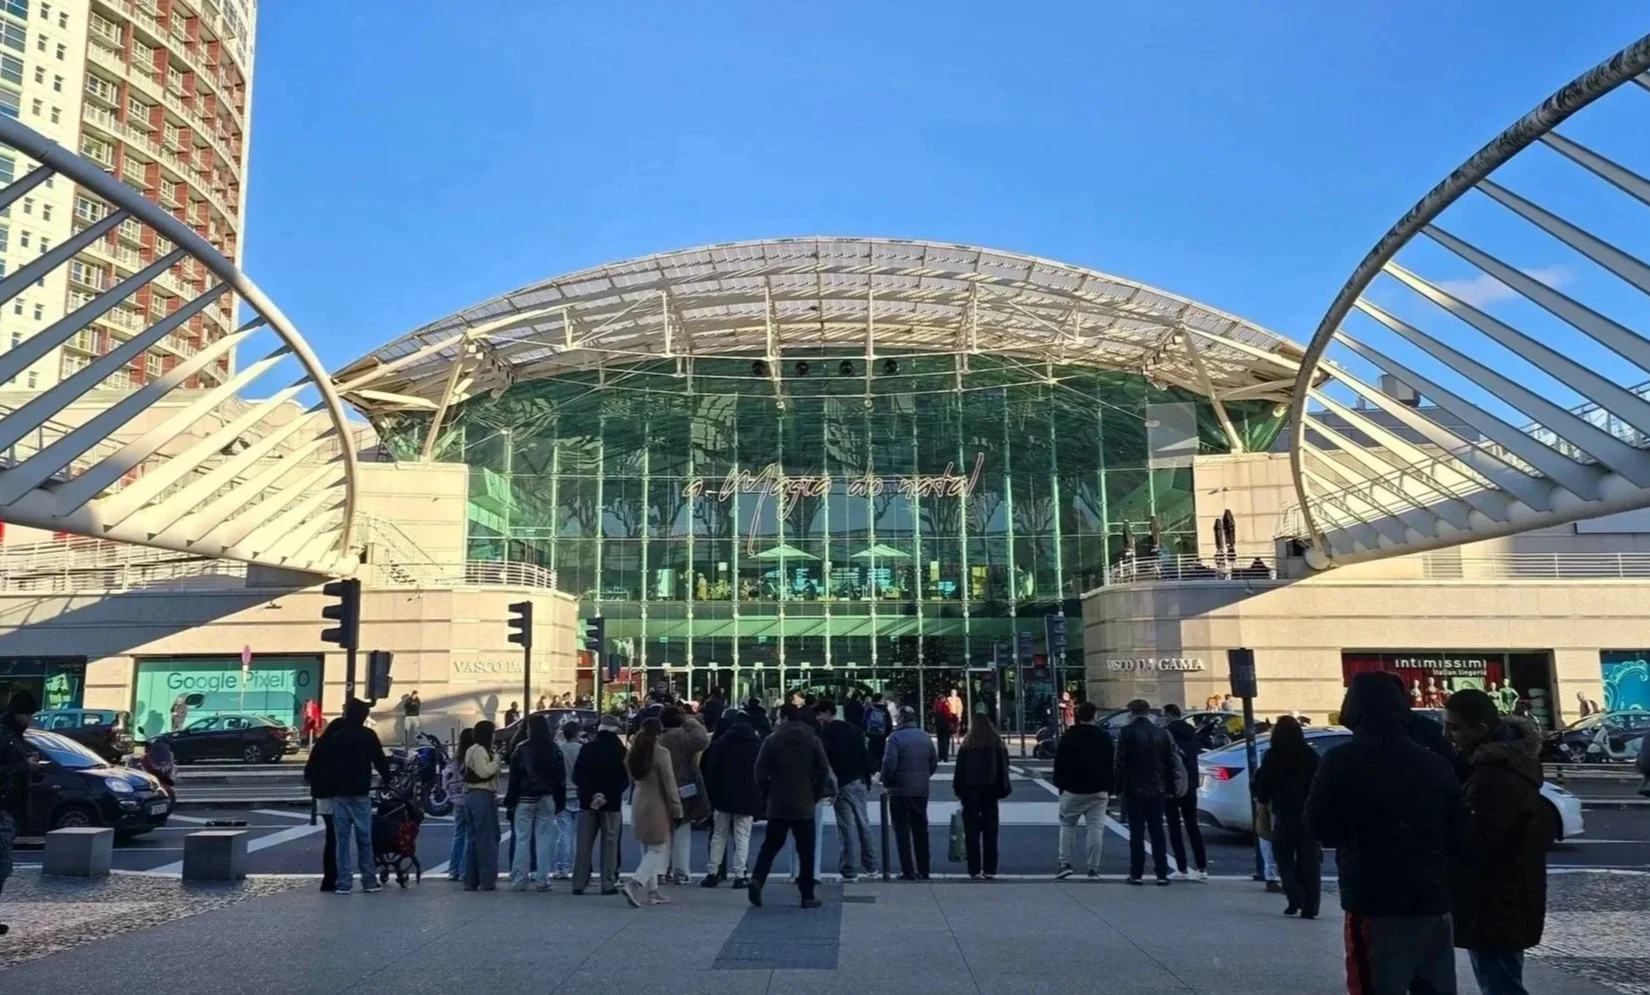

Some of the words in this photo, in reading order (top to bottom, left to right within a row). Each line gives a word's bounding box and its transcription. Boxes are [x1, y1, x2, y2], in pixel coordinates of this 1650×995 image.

[847, 458, 884, 497] do
[898, 452, 985, 499] natal
[453, 661, 502, 673] VASCO
[1158, 658, 1207, 671] GAMA
[1395, 657, 1487, 669] intimissimi
[167, 672, 237, 692] Google
[243, 671, 284, 688] Pixel
[289, 670, 310, 688] 10
